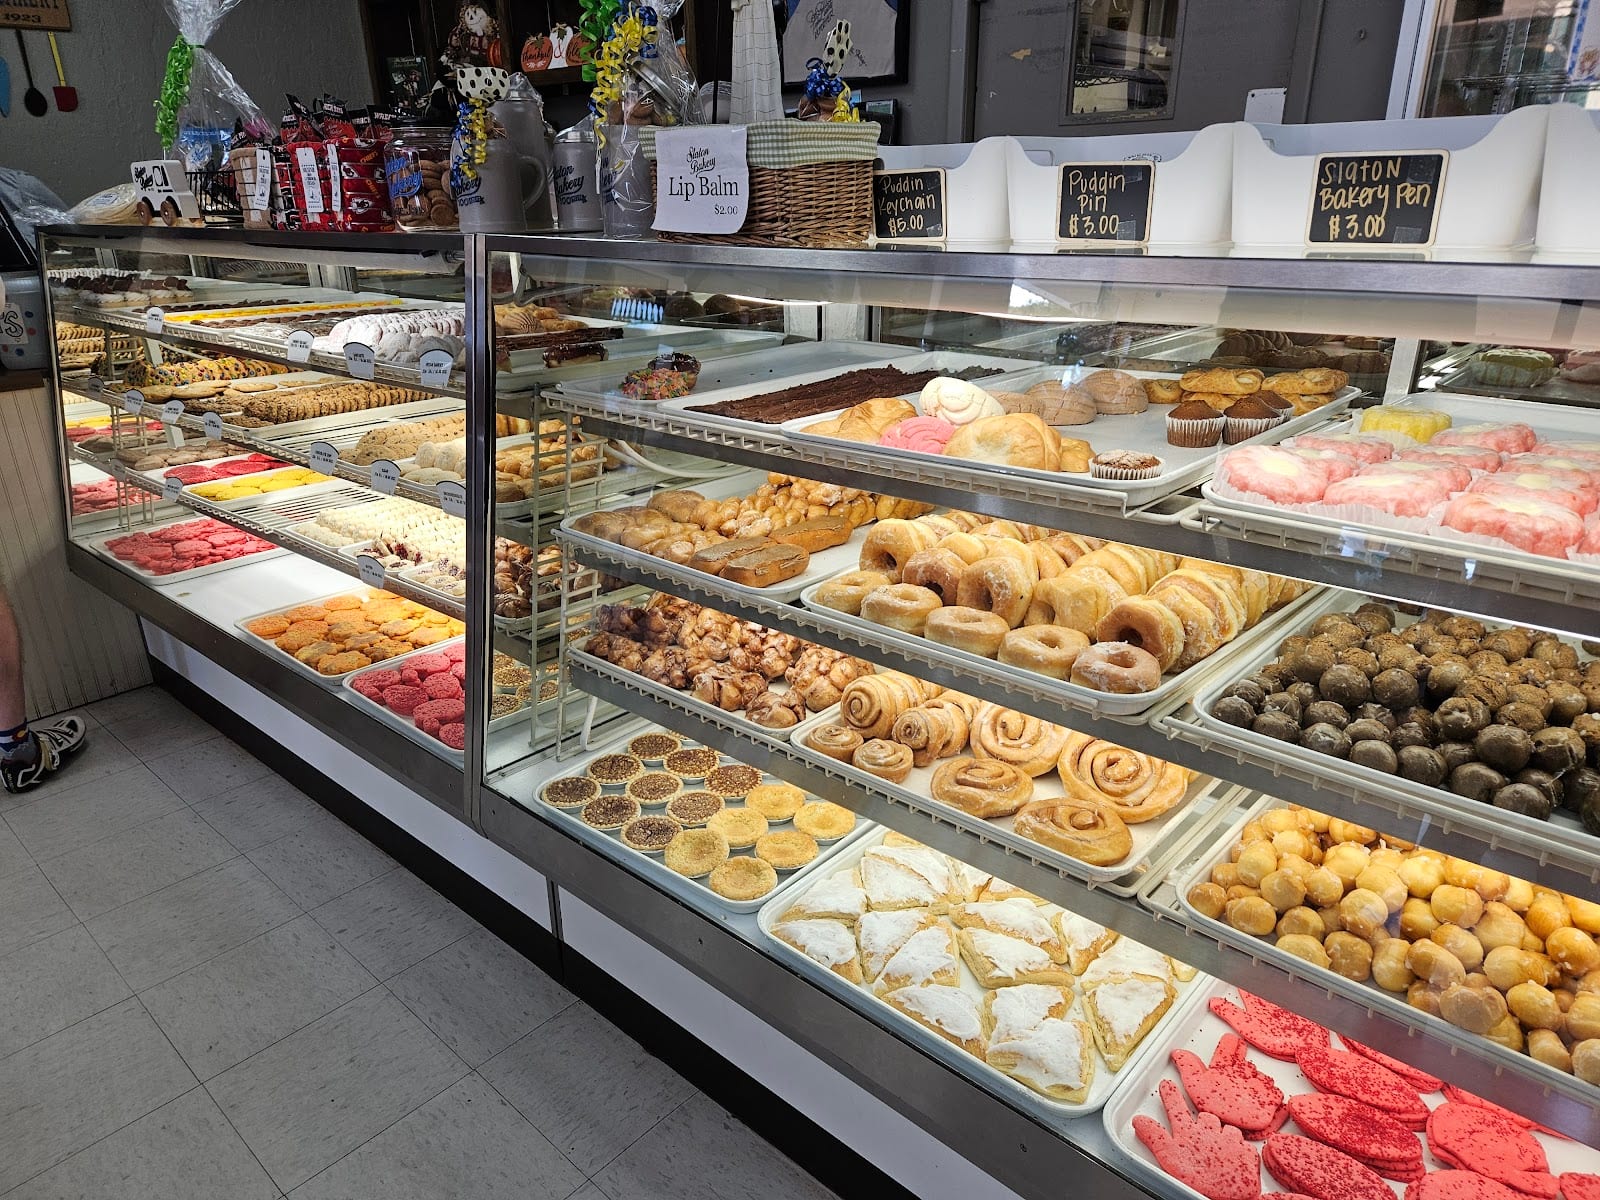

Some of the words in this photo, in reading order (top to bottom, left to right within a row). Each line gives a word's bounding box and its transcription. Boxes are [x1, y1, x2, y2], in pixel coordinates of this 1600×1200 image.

[4, 12, 42, 24] 1923
[687, 146, 709, 162] Slaton
[690, 157, 716, 178] Bakery
[668, 175, 695, 201] Lip
[699, 175, 739, 196] Balm
[880, 175, 924, 195] Puddin
[1069, 169, 1126, 195] Puddin
[714, 203, 738, 215] $2.00
[879, 193, 936, 217] Keychain
[1319, 184, 1389, 218] Bakery
[888, 214, 924, 238] $5.00
[1069, 213, 1119, 238] $3.00
[1329, 214, 1386, 241] $3.00
